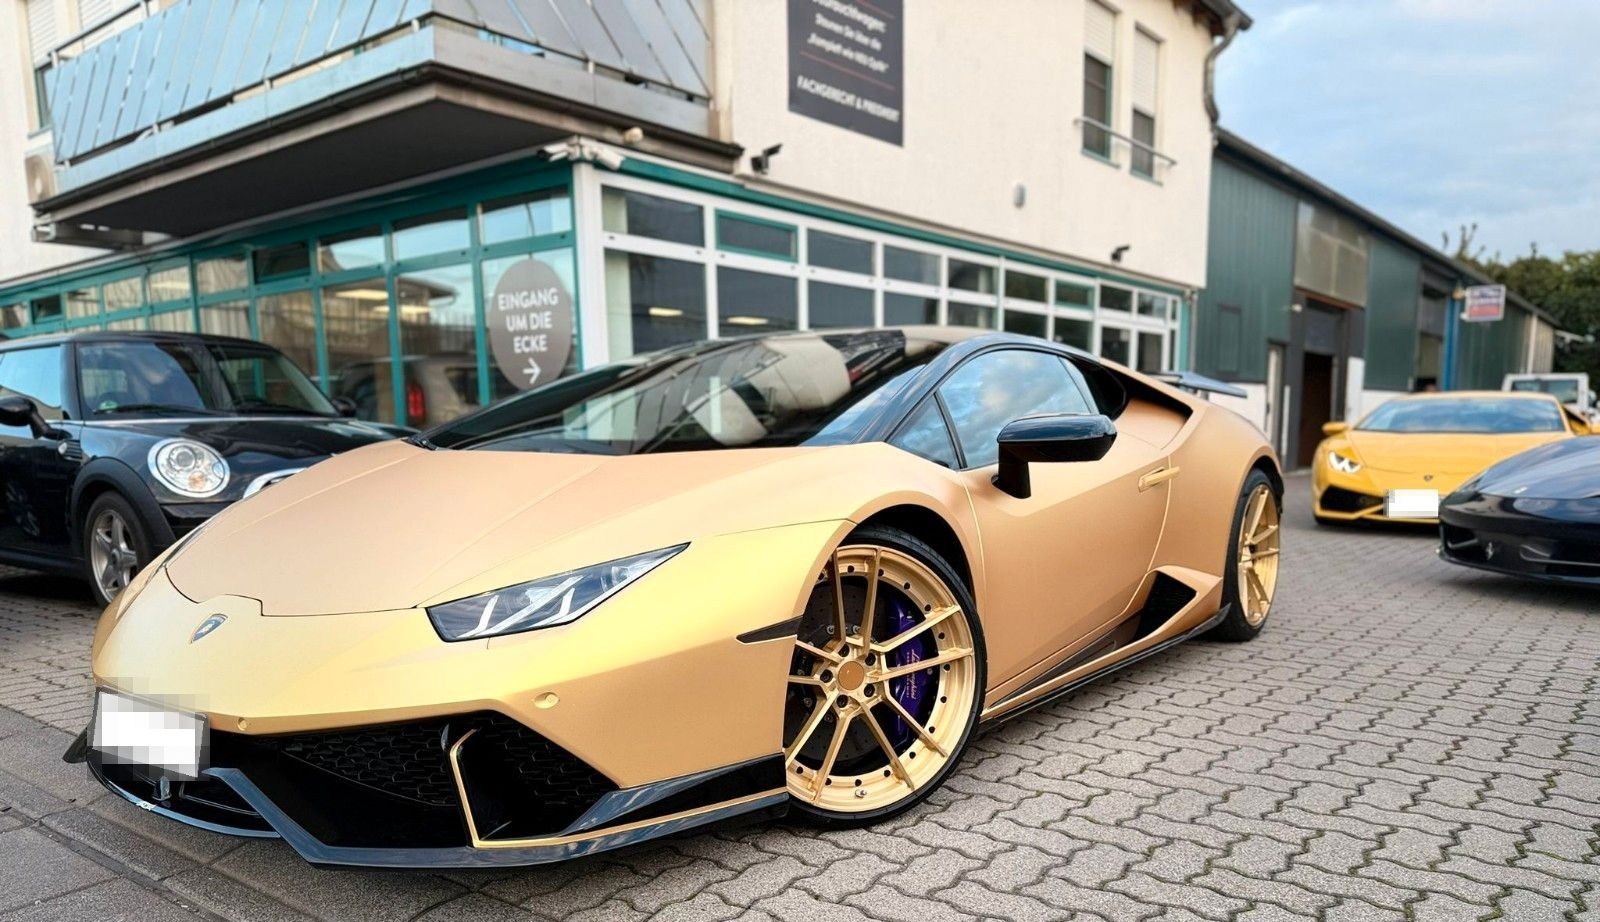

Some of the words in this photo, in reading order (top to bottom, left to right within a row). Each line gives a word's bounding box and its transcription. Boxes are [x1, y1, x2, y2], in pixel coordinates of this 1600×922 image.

[797, 75, 856, 108] FACHGERECHT
[856, 96, 863, 110] &
[498, 287, 560, 311] EINGANG
[505, 313, 529, 332] UM
[529, 311, 553, 330] DIE
[513, 334, 547, 353] ECKE
